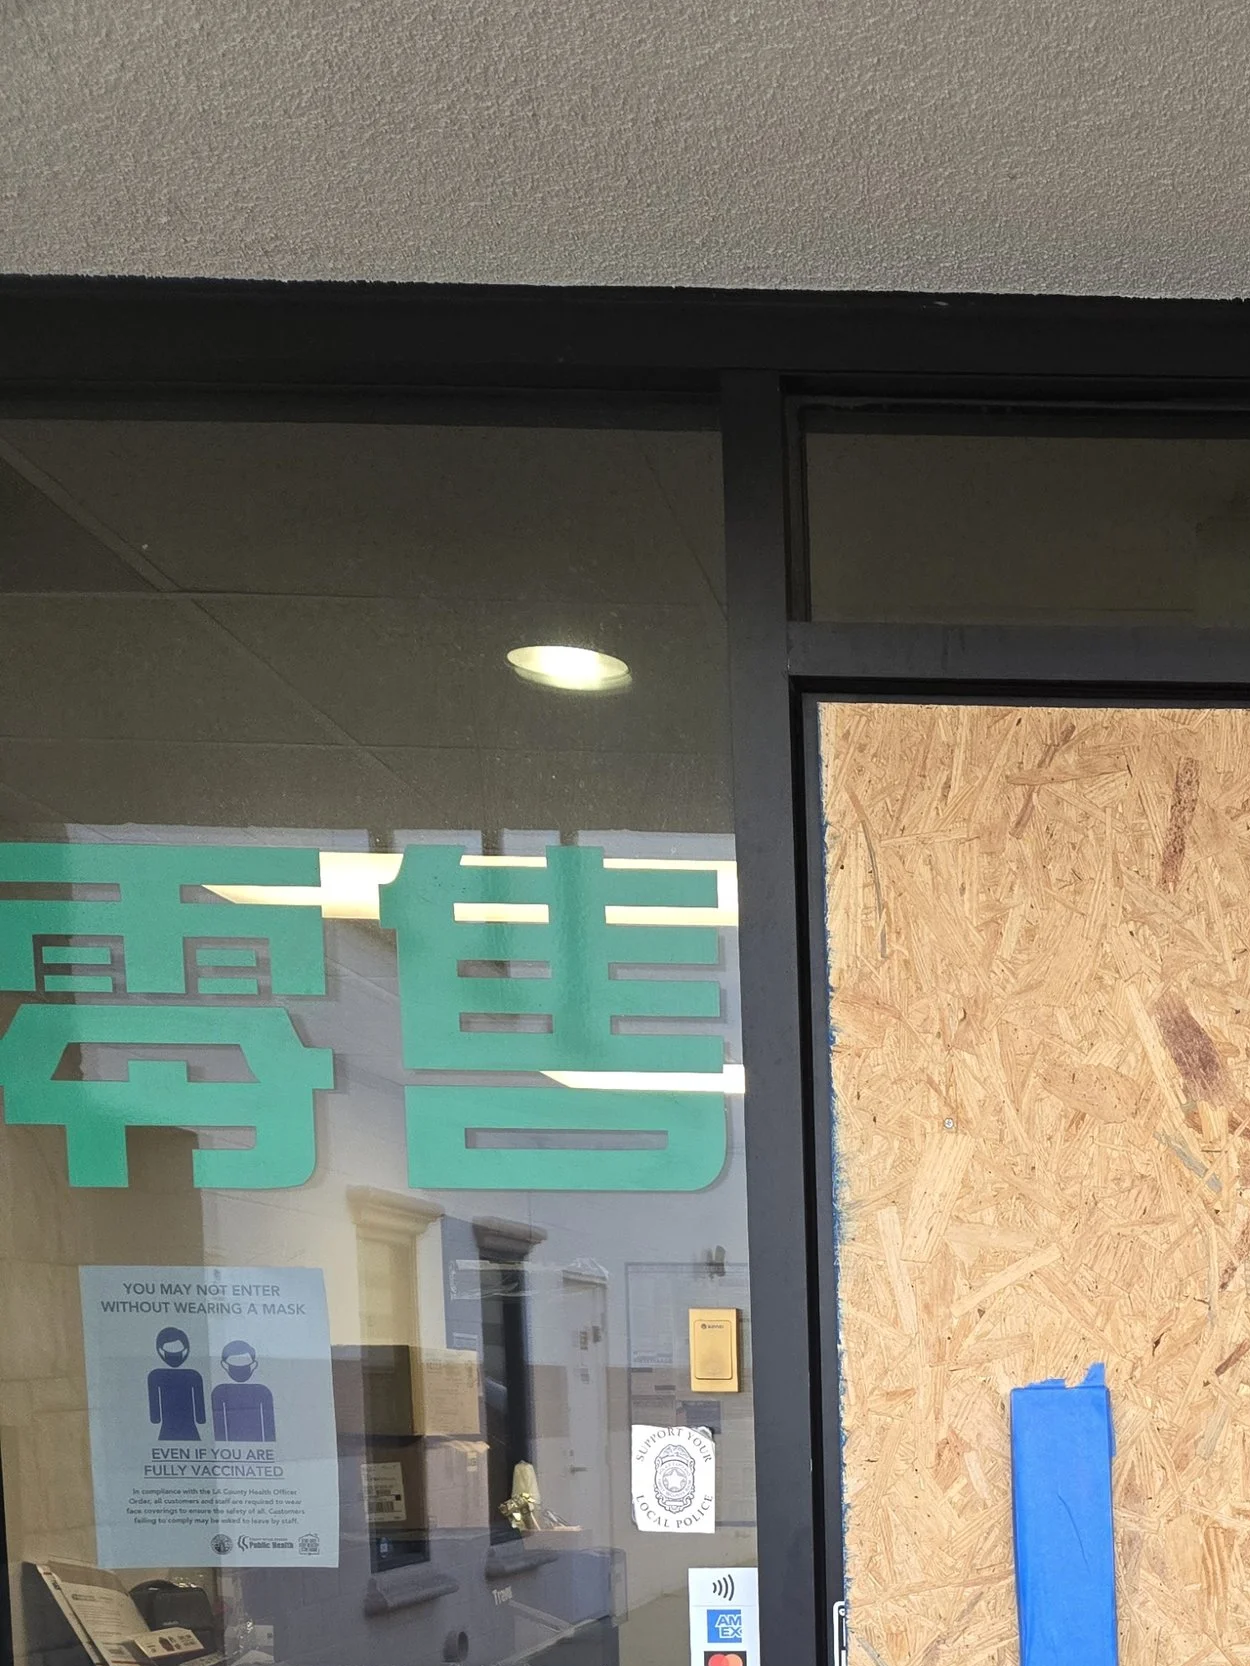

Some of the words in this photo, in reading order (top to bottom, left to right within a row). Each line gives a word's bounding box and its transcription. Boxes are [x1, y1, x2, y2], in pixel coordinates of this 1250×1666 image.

[0, 843, 728, 1191] 零售
[122, 1282, 156, 1297] YOU
[160, 1282, 192, 1297] MAY
[196, 1282, 227, 1298] NOT
[231, 1283, 281, 1298] ENTER
[100, 1299, 171, 1315] WITHOUT
[173, 1300, 242, 1316] WEARING
[246, 1302, 259, 1315] A
[262, 1302, 307, 1316] MASK
[636, 1425, 683, 1462] SUPPORT
[687, 1431, 713, 1463] YOUR
[151, 1446, 191, 1461] EVEN
[194, 1446, 208, 1461] IF
[210, 1446, 241, 1461] YOU
[243, 1447, 276, 1462] ARE
[143, 1464, 186, 1478] FULLY
[190, 1464, 284, 1479] VACCINATED
[635, 1494, 671, 1528] LOCAL
[676, 1494, 714, 1529] POLICE
